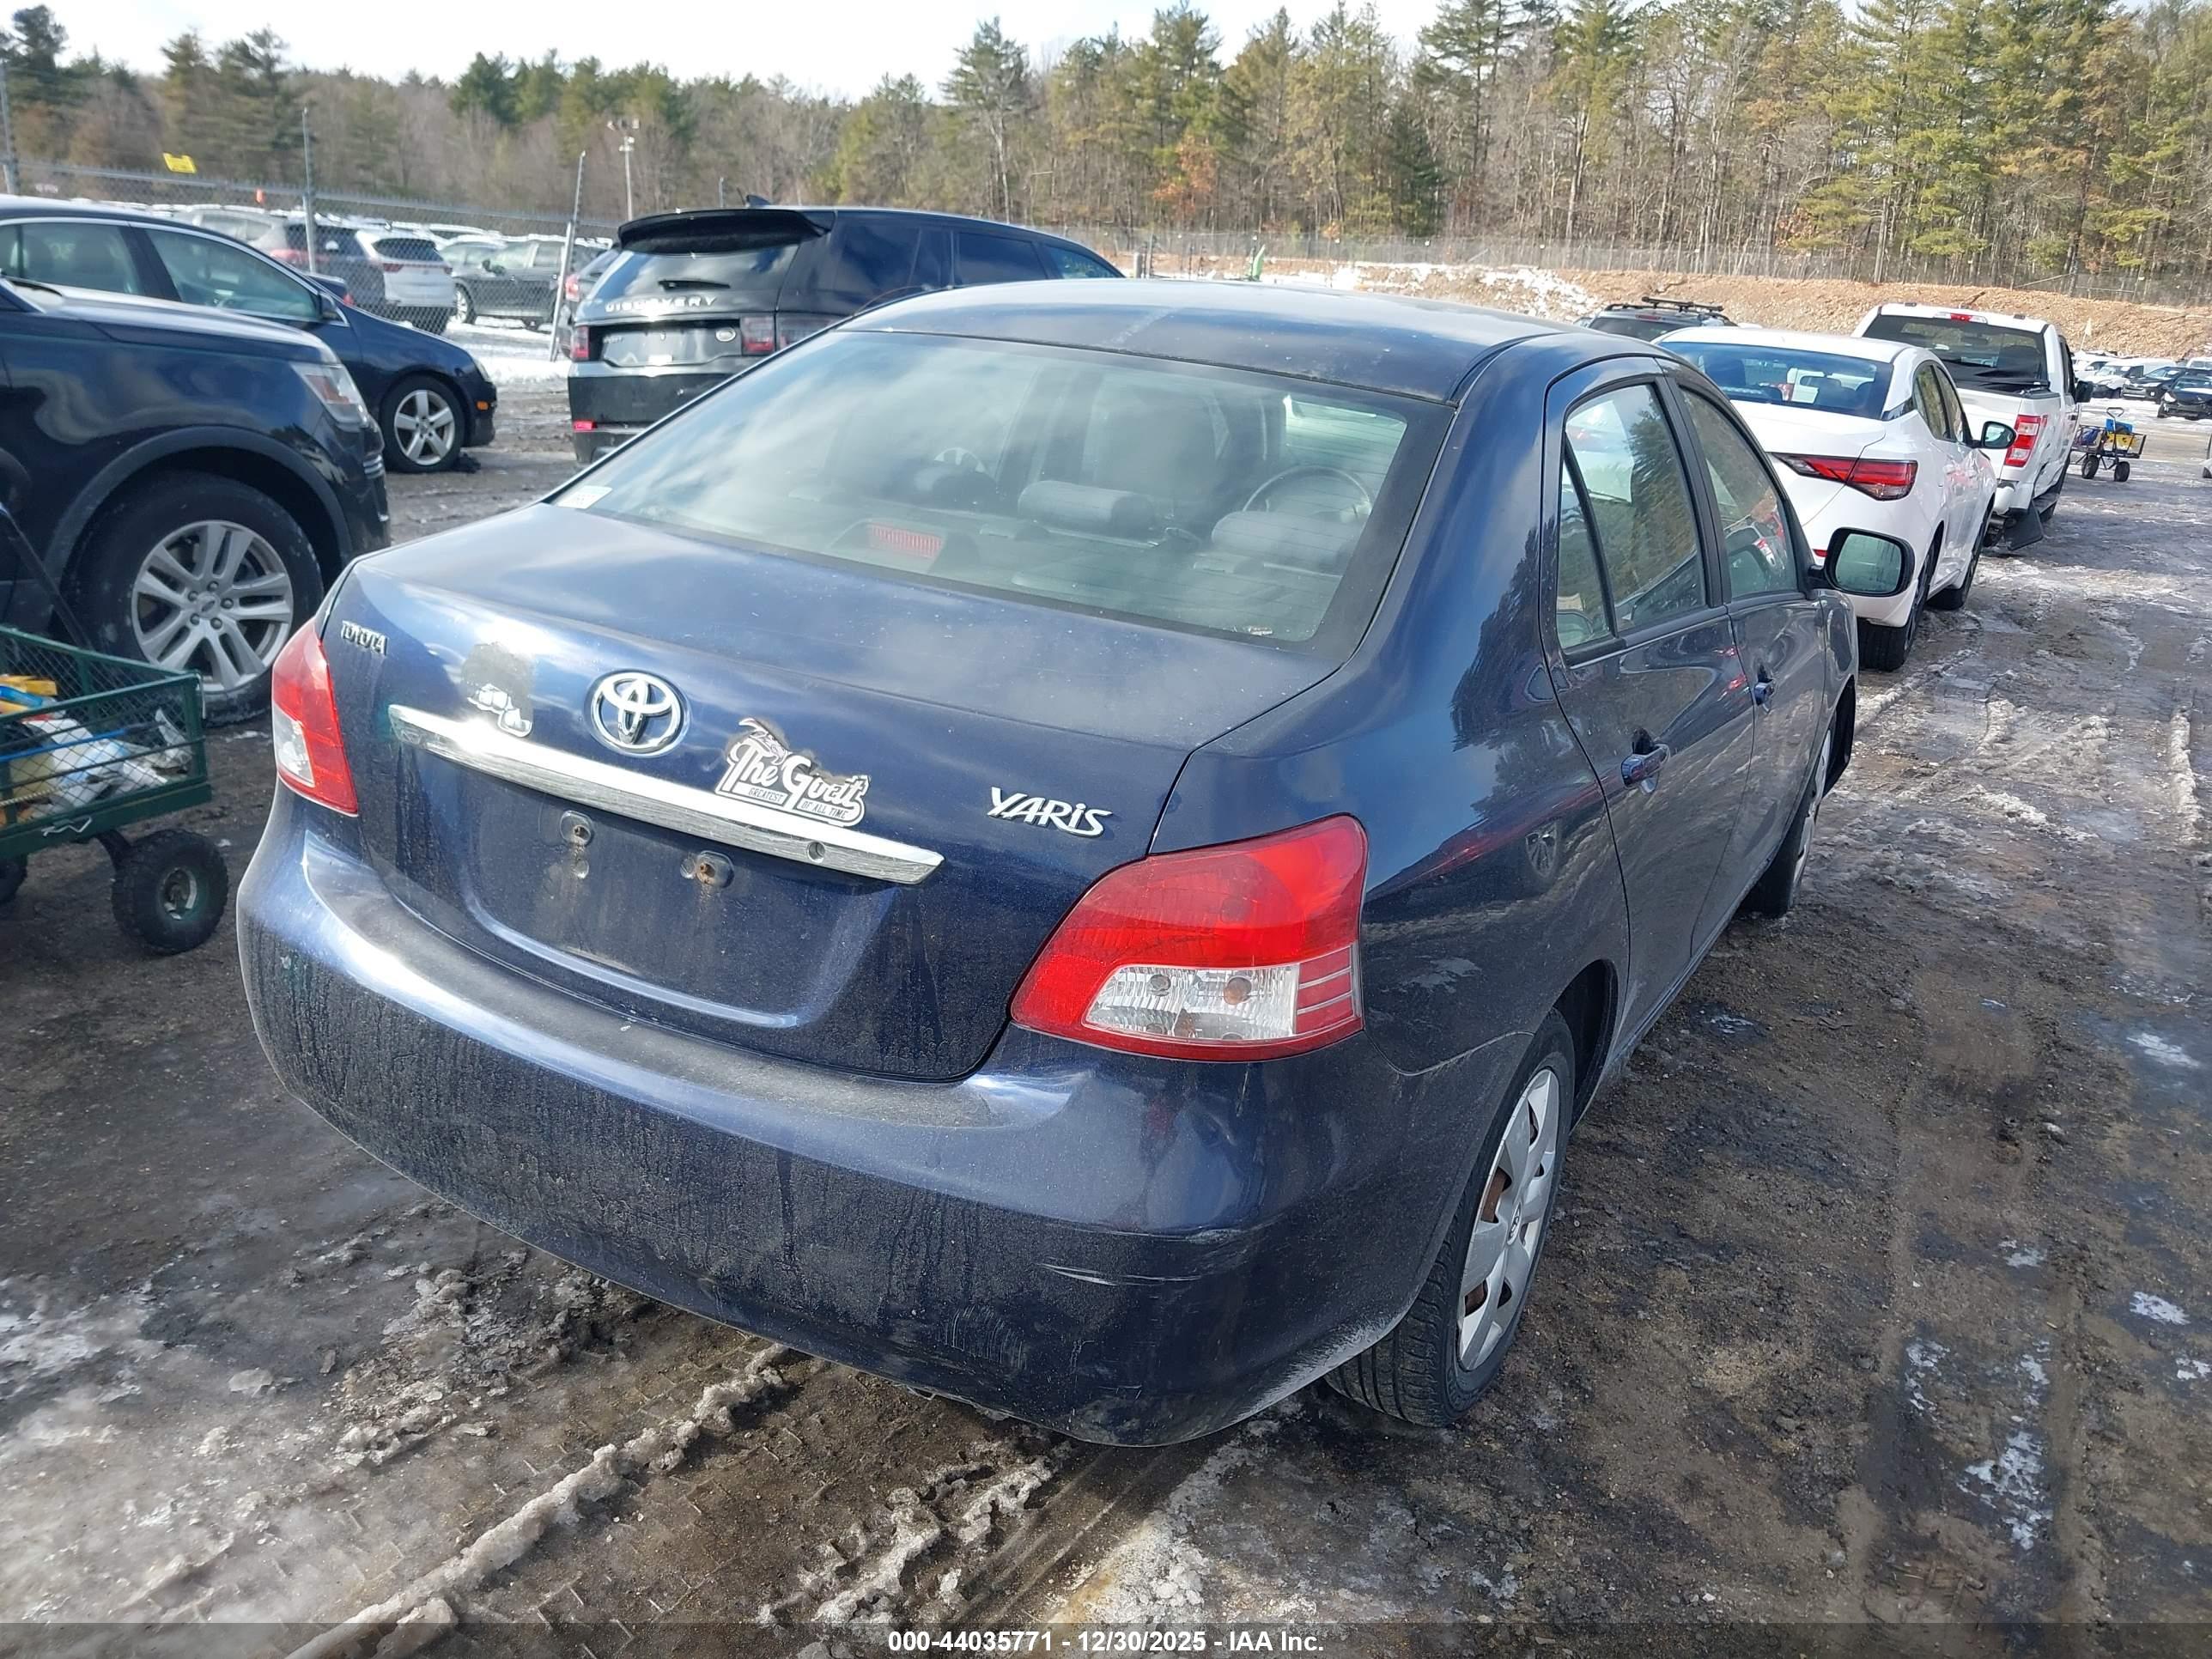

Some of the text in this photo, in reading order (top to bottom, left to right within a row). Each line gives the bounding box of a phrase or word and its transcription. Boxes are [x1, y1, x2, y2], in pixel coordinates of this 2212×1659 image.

[341, 620, 386, 656] TOYOTA
[720, 738, 779, 793] The
[748, 787, 784, 803] GREATEST
[800, 801, 848, 819] OF ALL TIME
